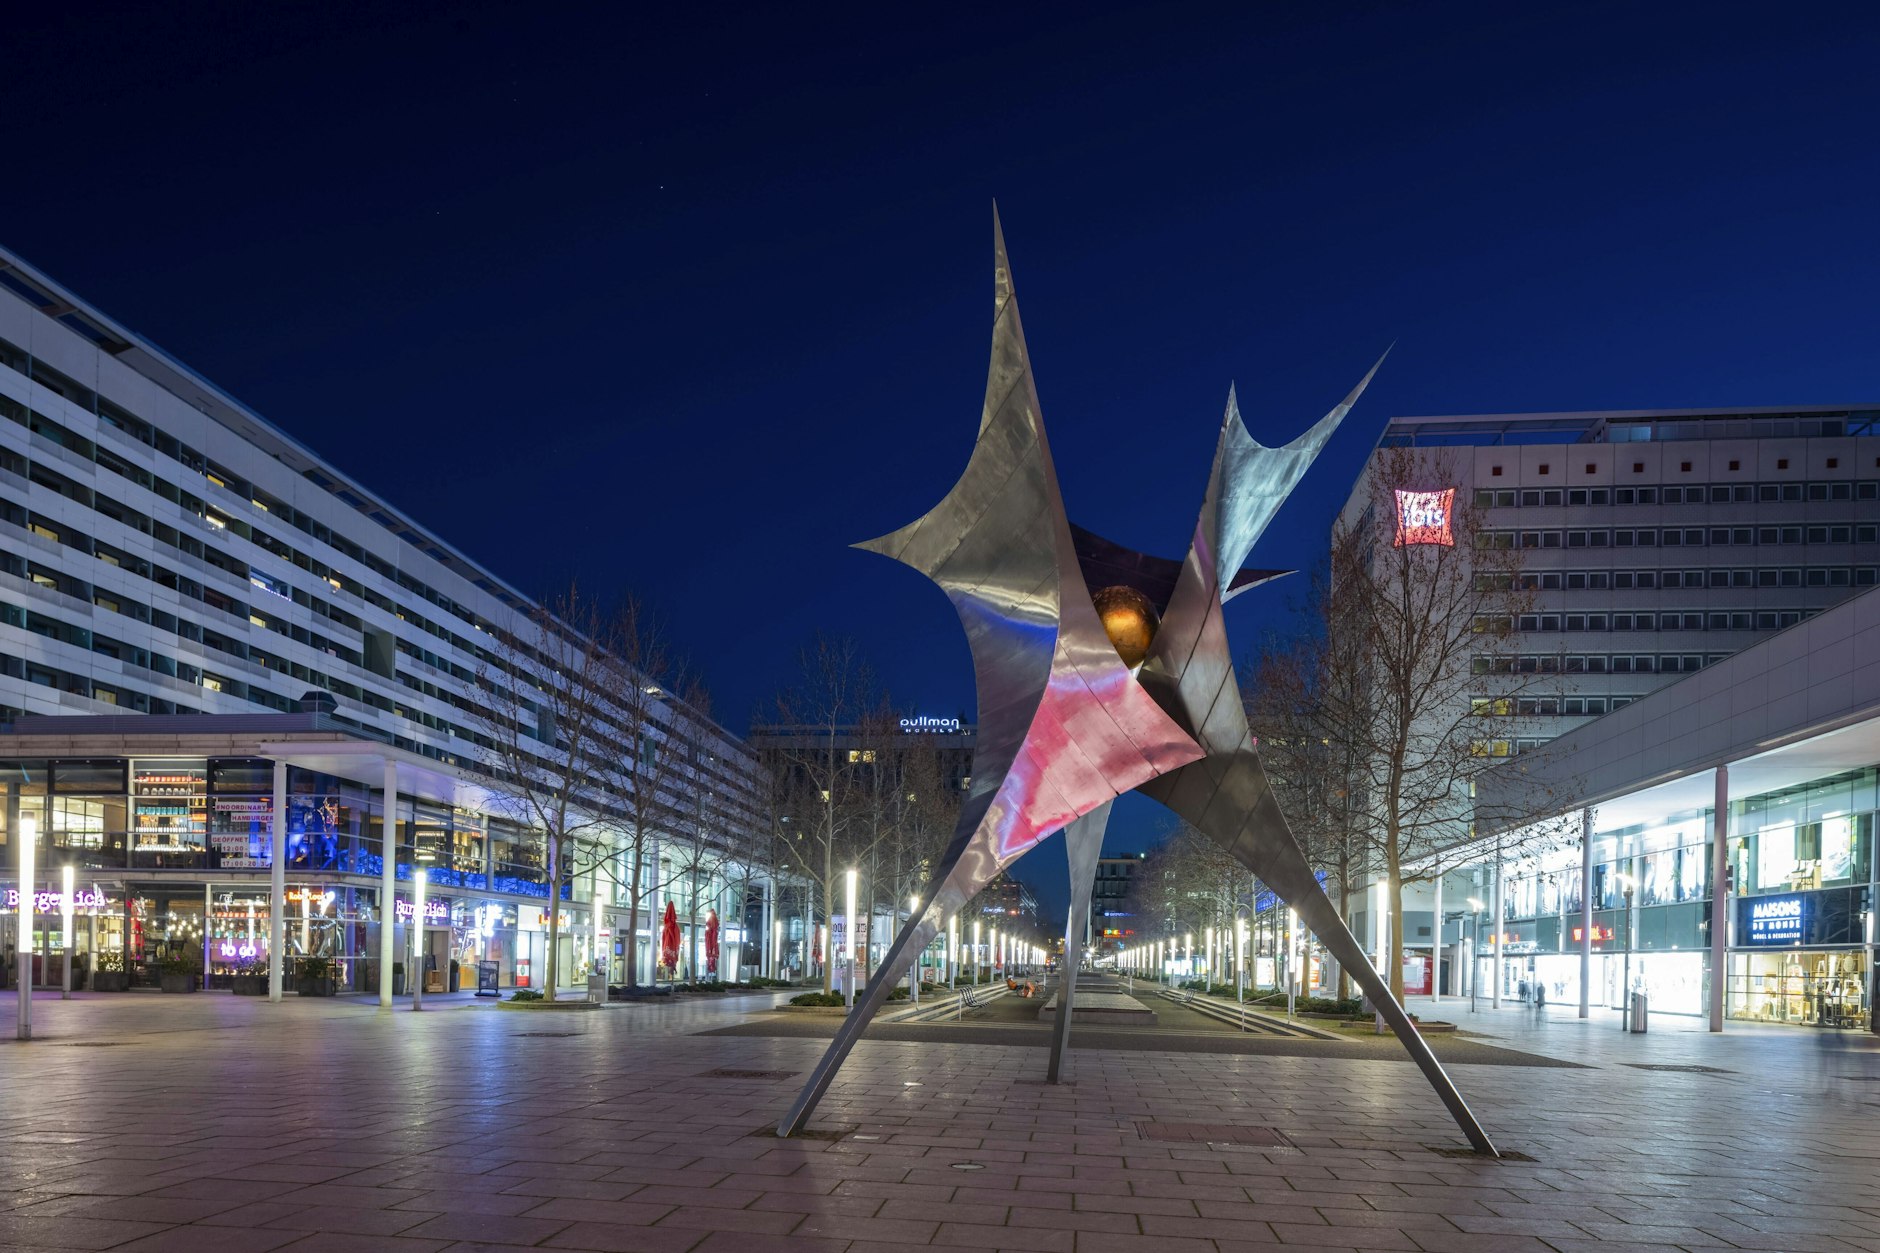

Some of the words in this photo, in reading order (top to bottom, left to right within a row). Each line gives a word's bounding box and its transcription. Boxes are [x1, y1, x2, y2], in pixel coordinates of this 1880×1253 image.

[900, 716, 960, 729] pullman
[1753, 900, 1801, 918] MAISONS
[1753, 922, 1764, 930] DU
[1769, 920, 1800, 929] MONDE
